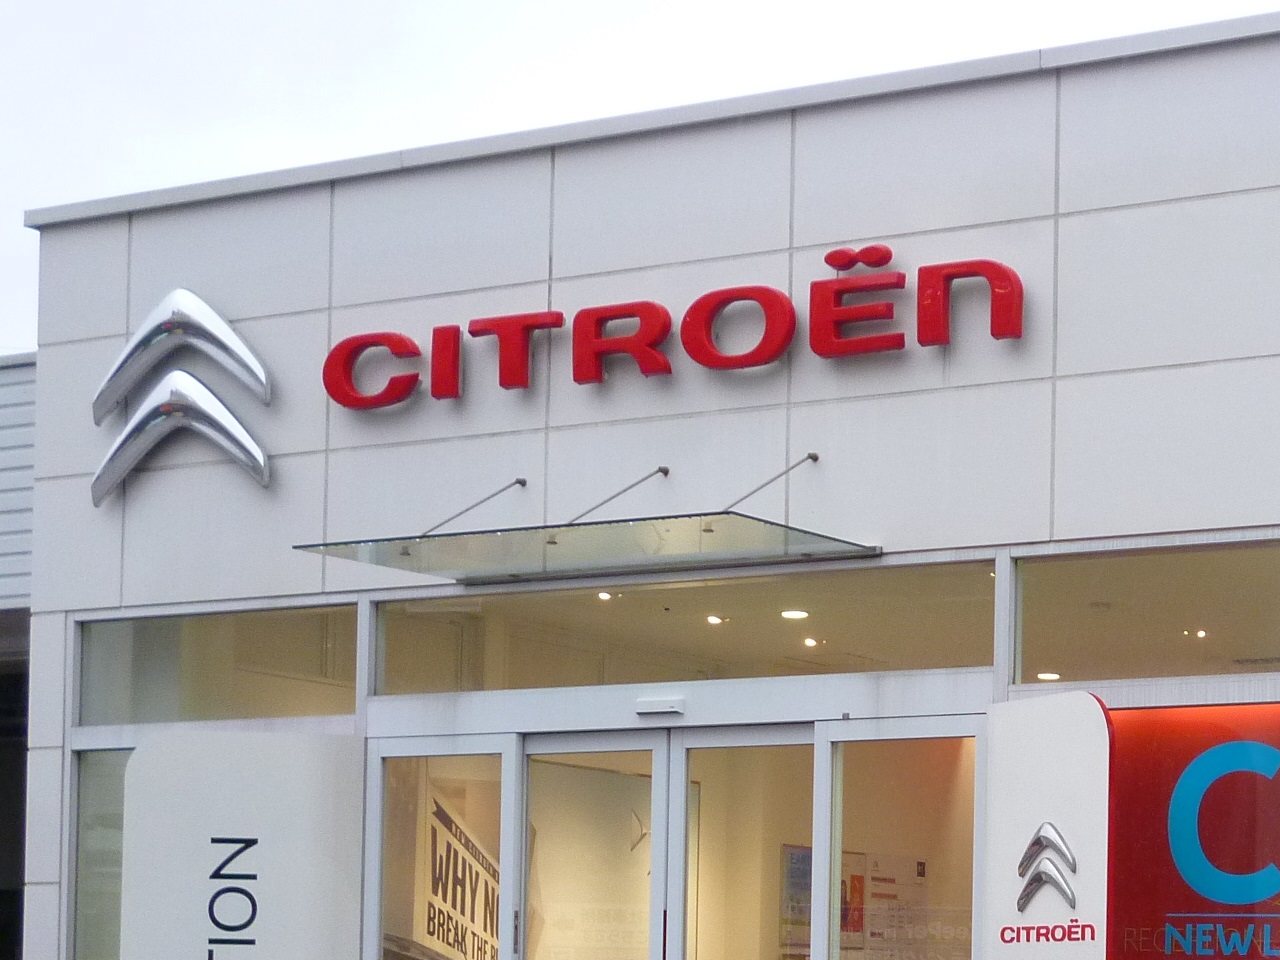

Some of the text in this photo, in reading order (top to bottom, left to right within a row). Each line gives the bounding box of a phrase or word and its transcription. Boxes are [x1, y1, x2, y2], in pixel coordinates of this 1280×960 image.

[430, 824, 480, 924] WHY
[427, 900, 469, 957] BREAK
[1164, 923, 1254, 956] NEW
